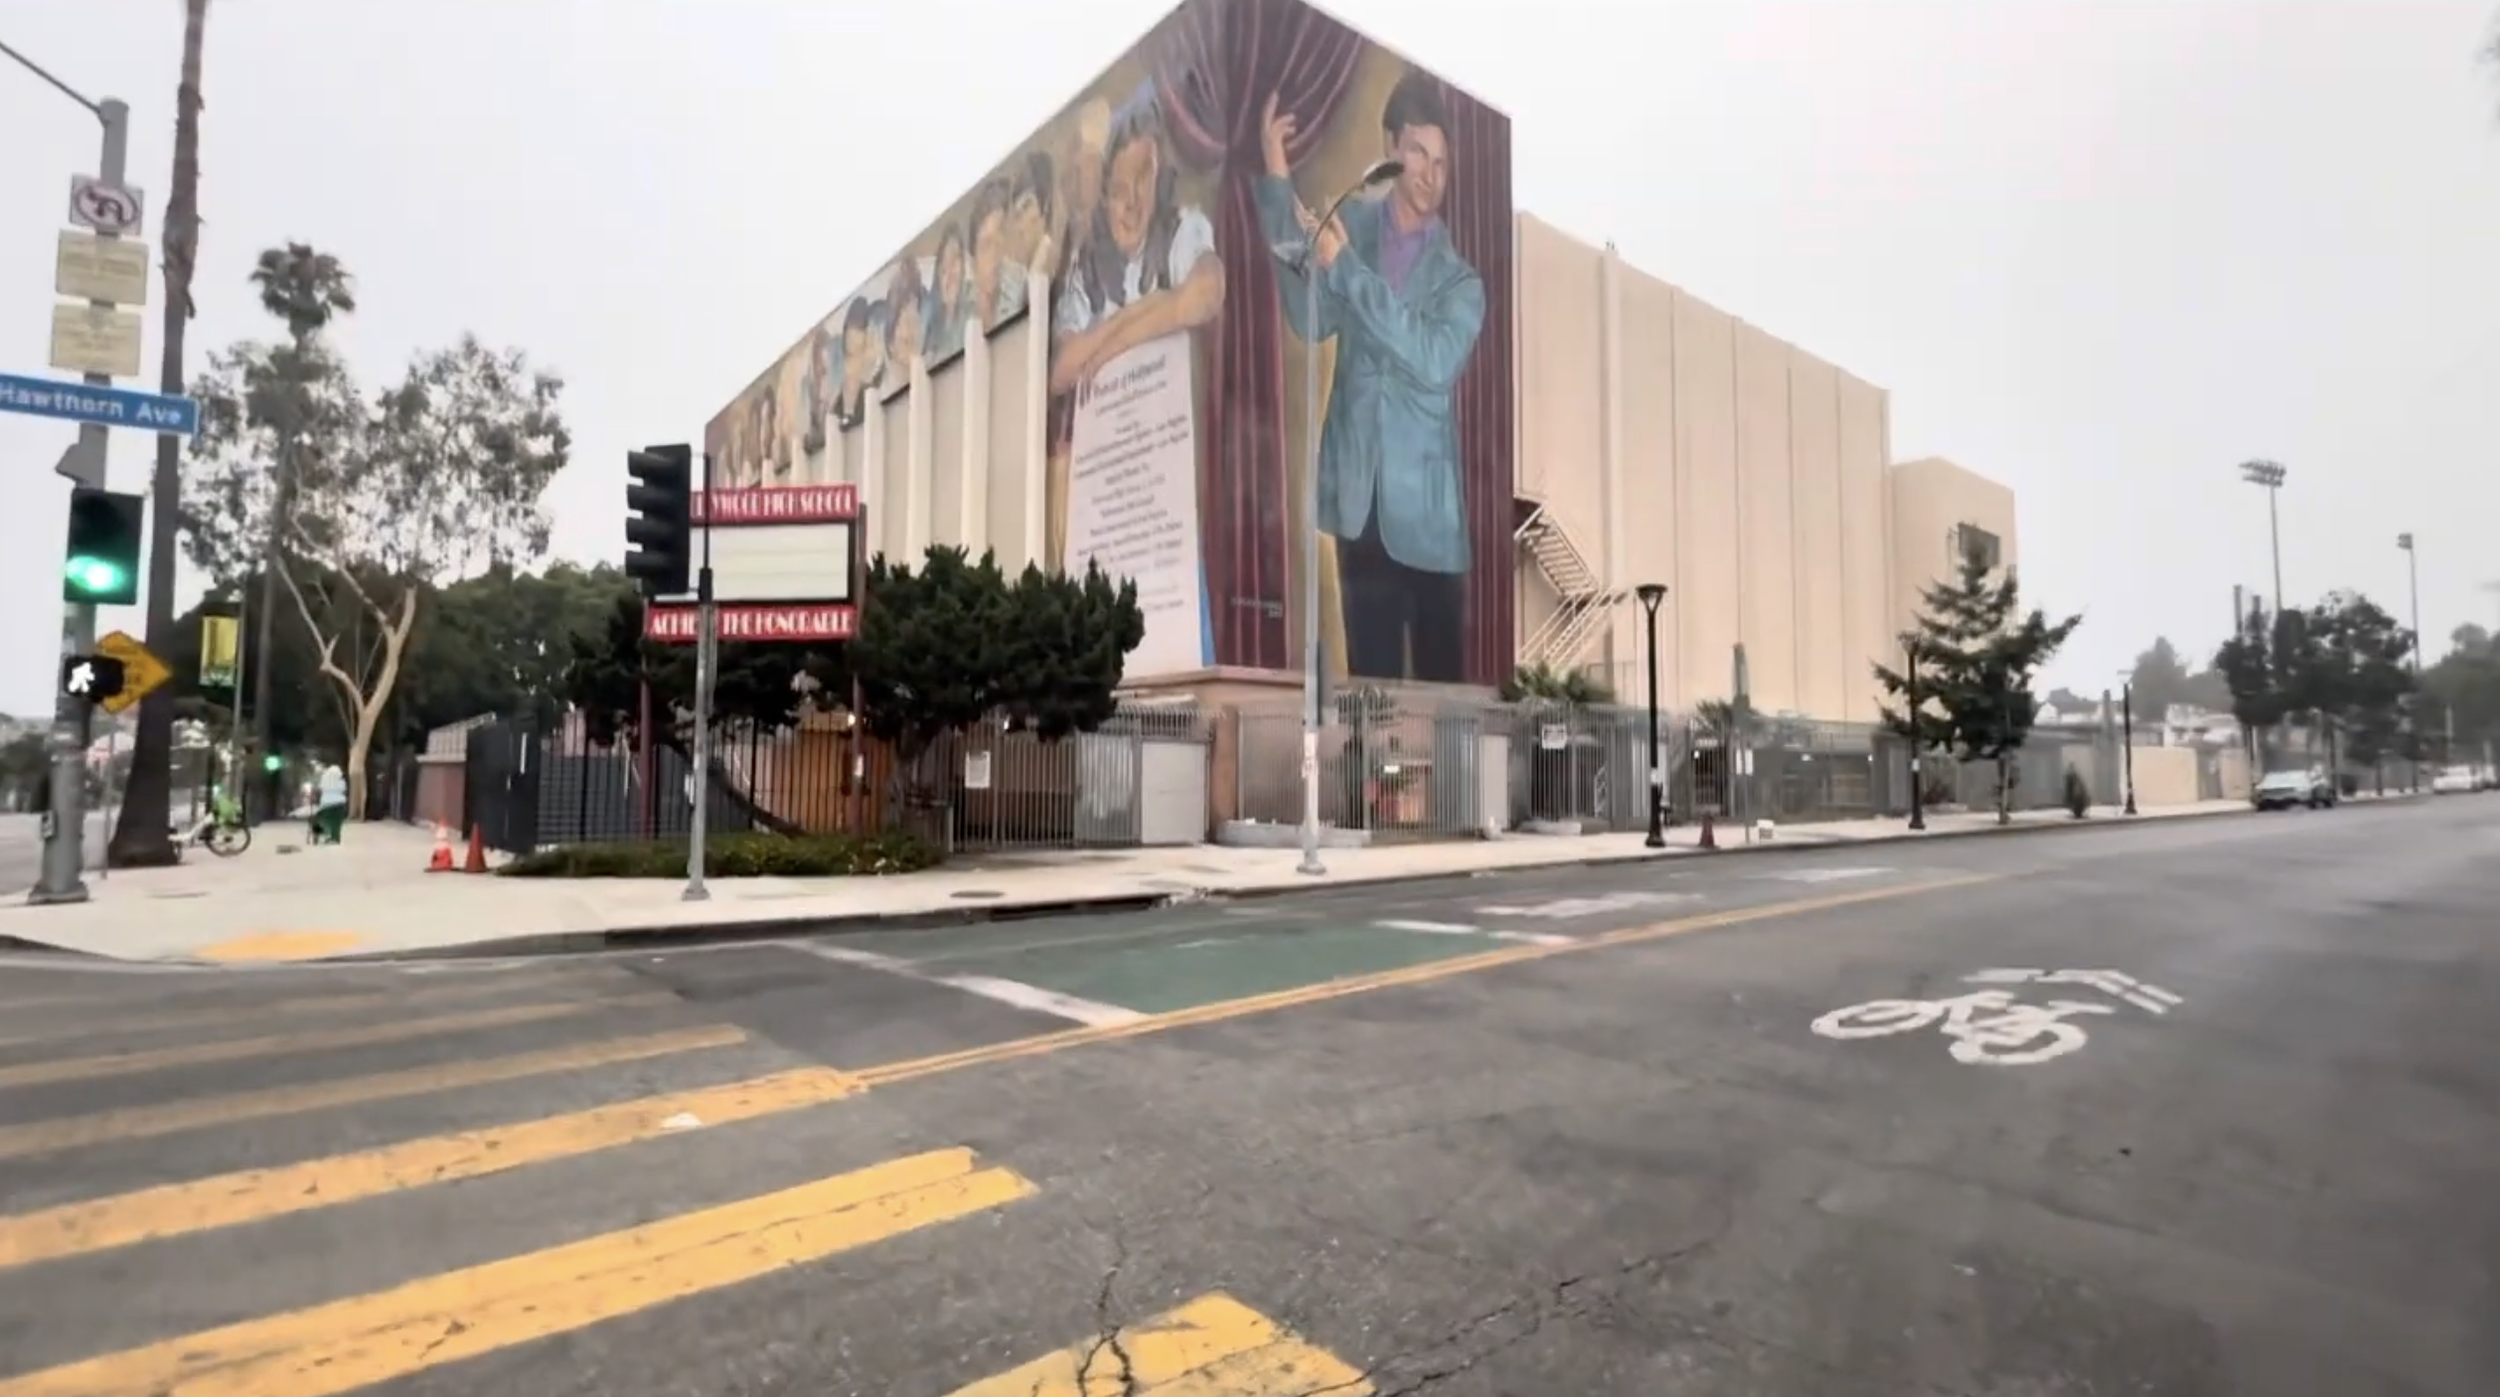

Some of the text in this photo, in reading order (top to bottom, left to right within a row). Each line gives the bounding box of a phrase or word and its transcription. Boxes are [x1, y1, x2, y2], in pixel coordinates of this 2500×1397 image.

[0, 381, 183, 425] Hawthorn Ave
[763, 488, 798, 517] HIGH
[801, 485, 854, 515] SCHOOL
[721, 611, 751, 637] THE
[754, 607, 851, 636] HONORABLE
